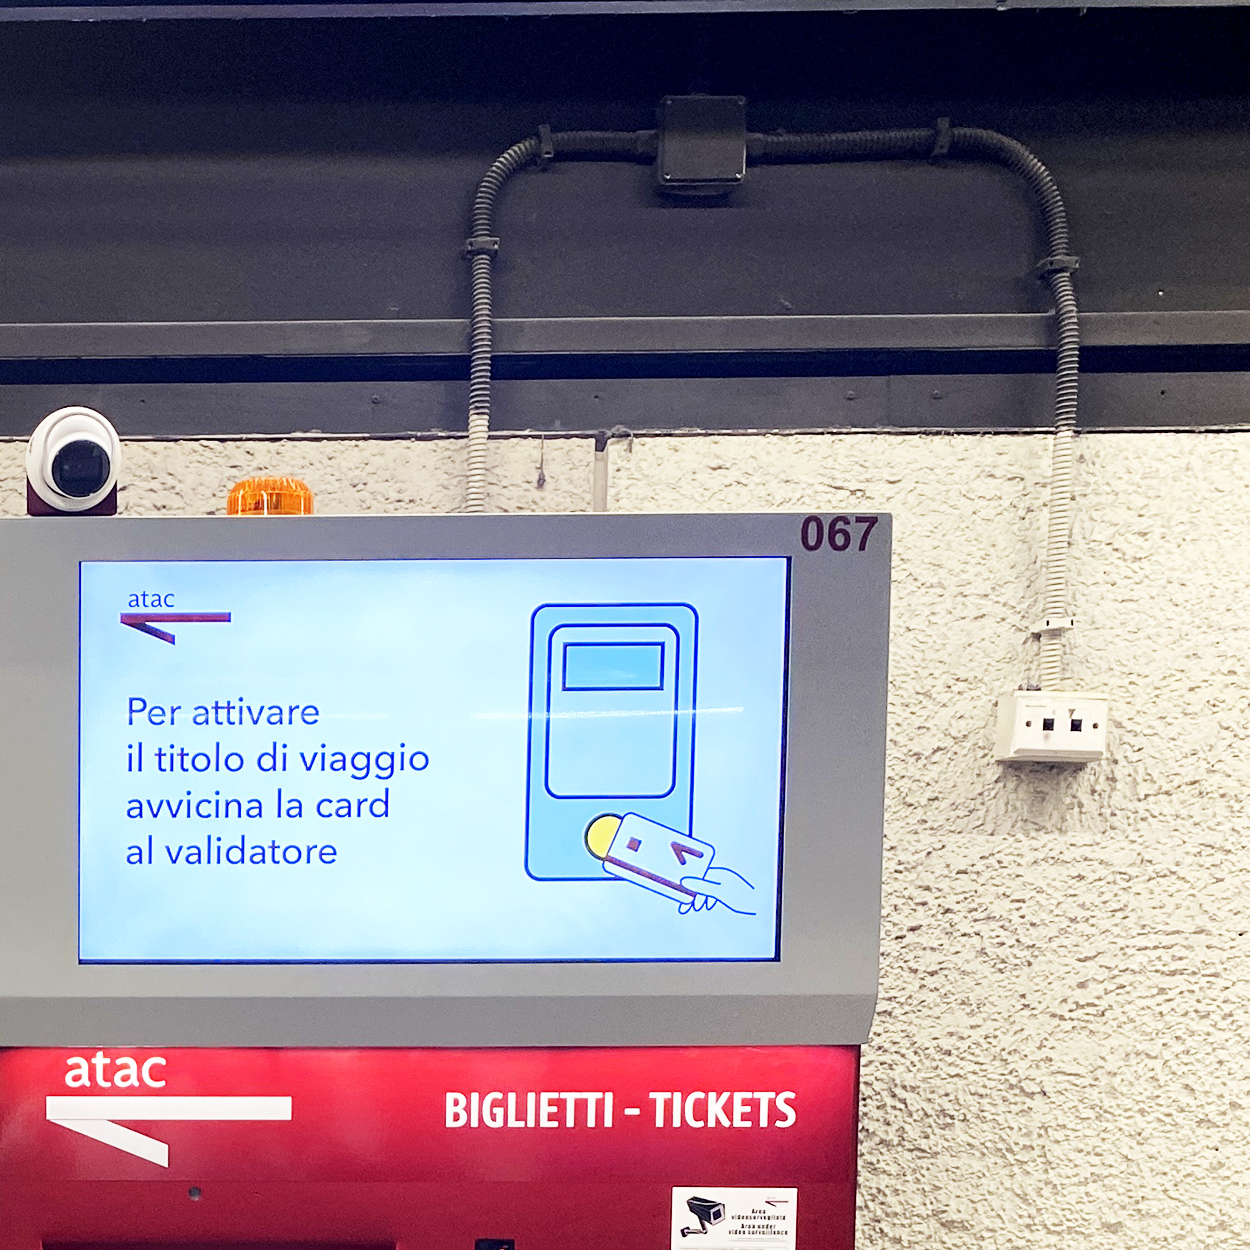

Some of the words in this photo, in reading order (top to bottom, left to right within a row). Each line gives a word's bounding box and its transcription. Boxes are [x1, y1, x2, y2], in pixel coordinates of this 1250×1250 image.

[801, 516, 878, 551] 067
[129, 591, 174, 607] atac
[129, 697, 181, 725] Per
[193, 697, 319, 725] attivare
[128, 742, 142, 772] il
[155, 742, 244, 772] titolo
[257, 741, 287, 772] di
[300, 743, 429, 780] viaggio
[127, 790, 262, 818] avvicina
[277, 788, 302, 818] la
[317, 788, 389, 818] card
[127, 835, 152, 864] al
[165, 835, 337, 864] validatore
[65, 1051, 166, 1087] atac
[446, 1092, 613, 1128] BIGLIETTI
[649, 1091, 796, 1127] TICKETS
